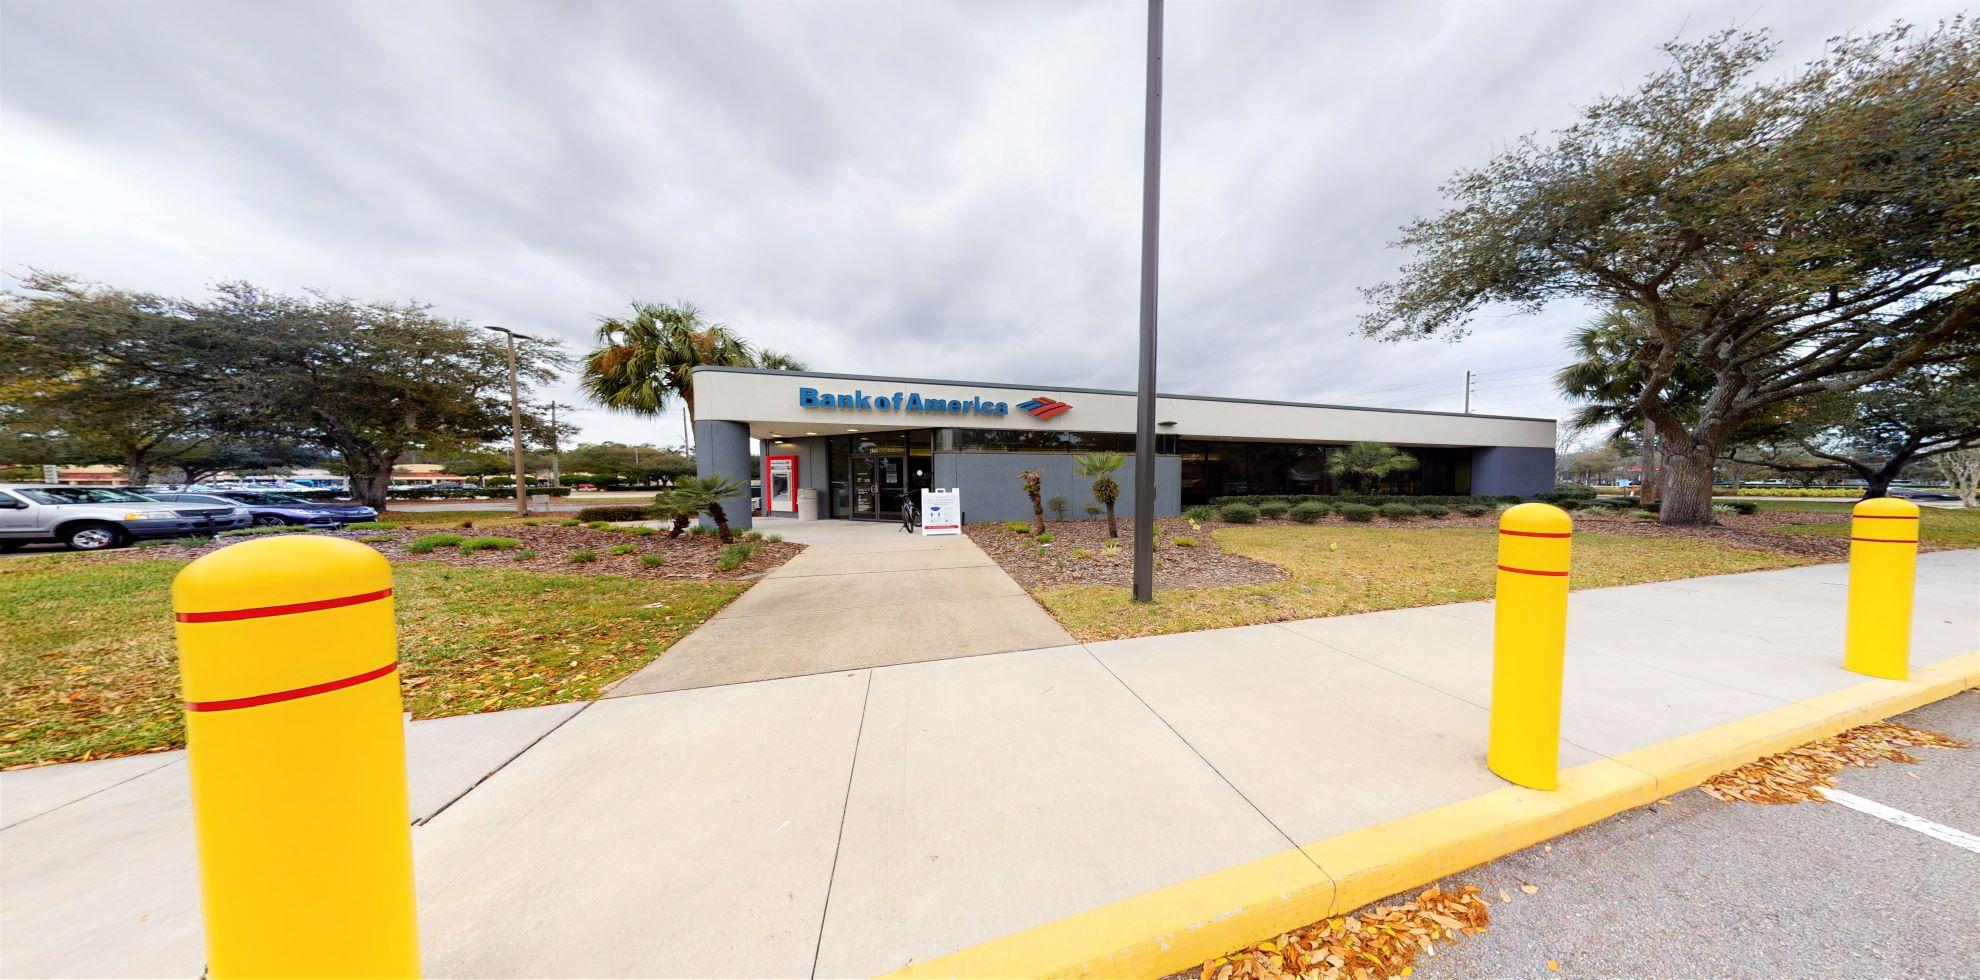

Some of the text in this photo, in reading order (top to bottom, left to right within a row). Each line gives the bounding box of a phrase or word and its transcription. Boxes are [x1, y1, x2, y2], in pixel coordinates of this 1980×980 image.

[799, 387, 1009, 416] Bank of America
